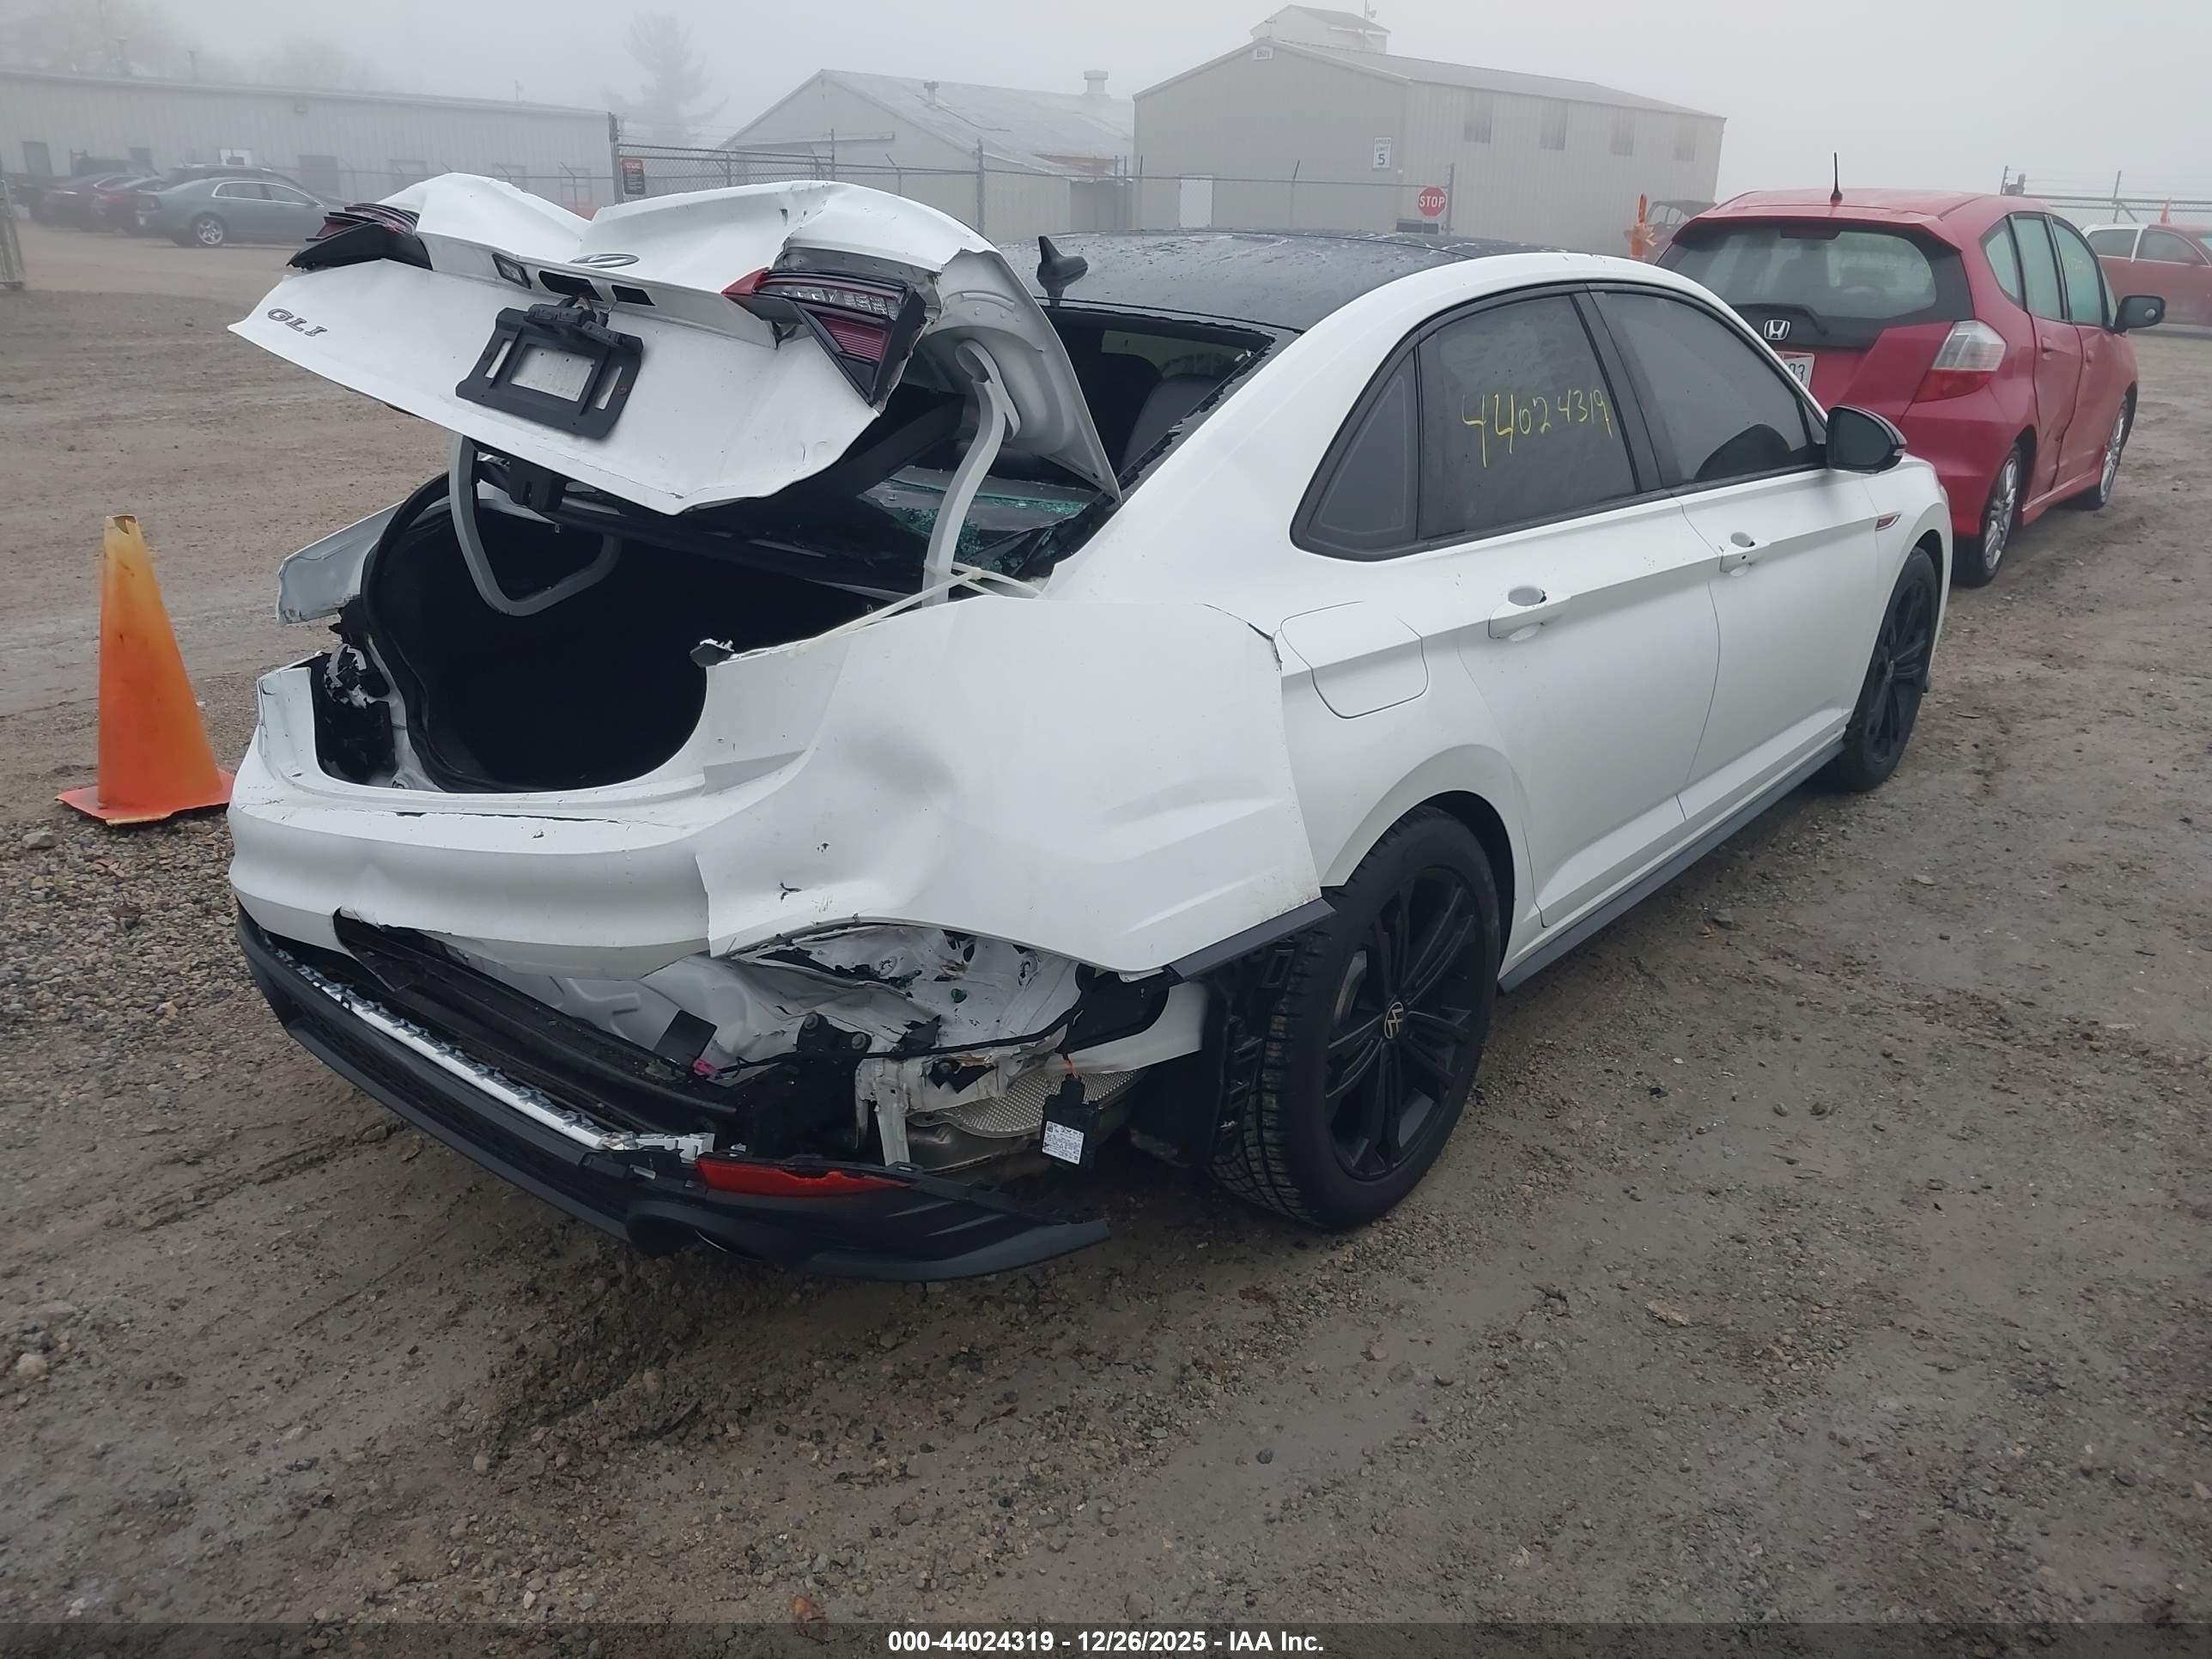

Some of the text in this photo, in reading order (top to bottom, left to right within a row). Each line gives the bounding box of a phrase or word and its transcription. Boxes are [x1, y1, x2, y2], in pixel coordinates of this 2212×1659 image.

[1377, 153, 1386, 166] 5
[1419, 196, 1445, 208] STOP
[267, 307, 328, 337] GLI
